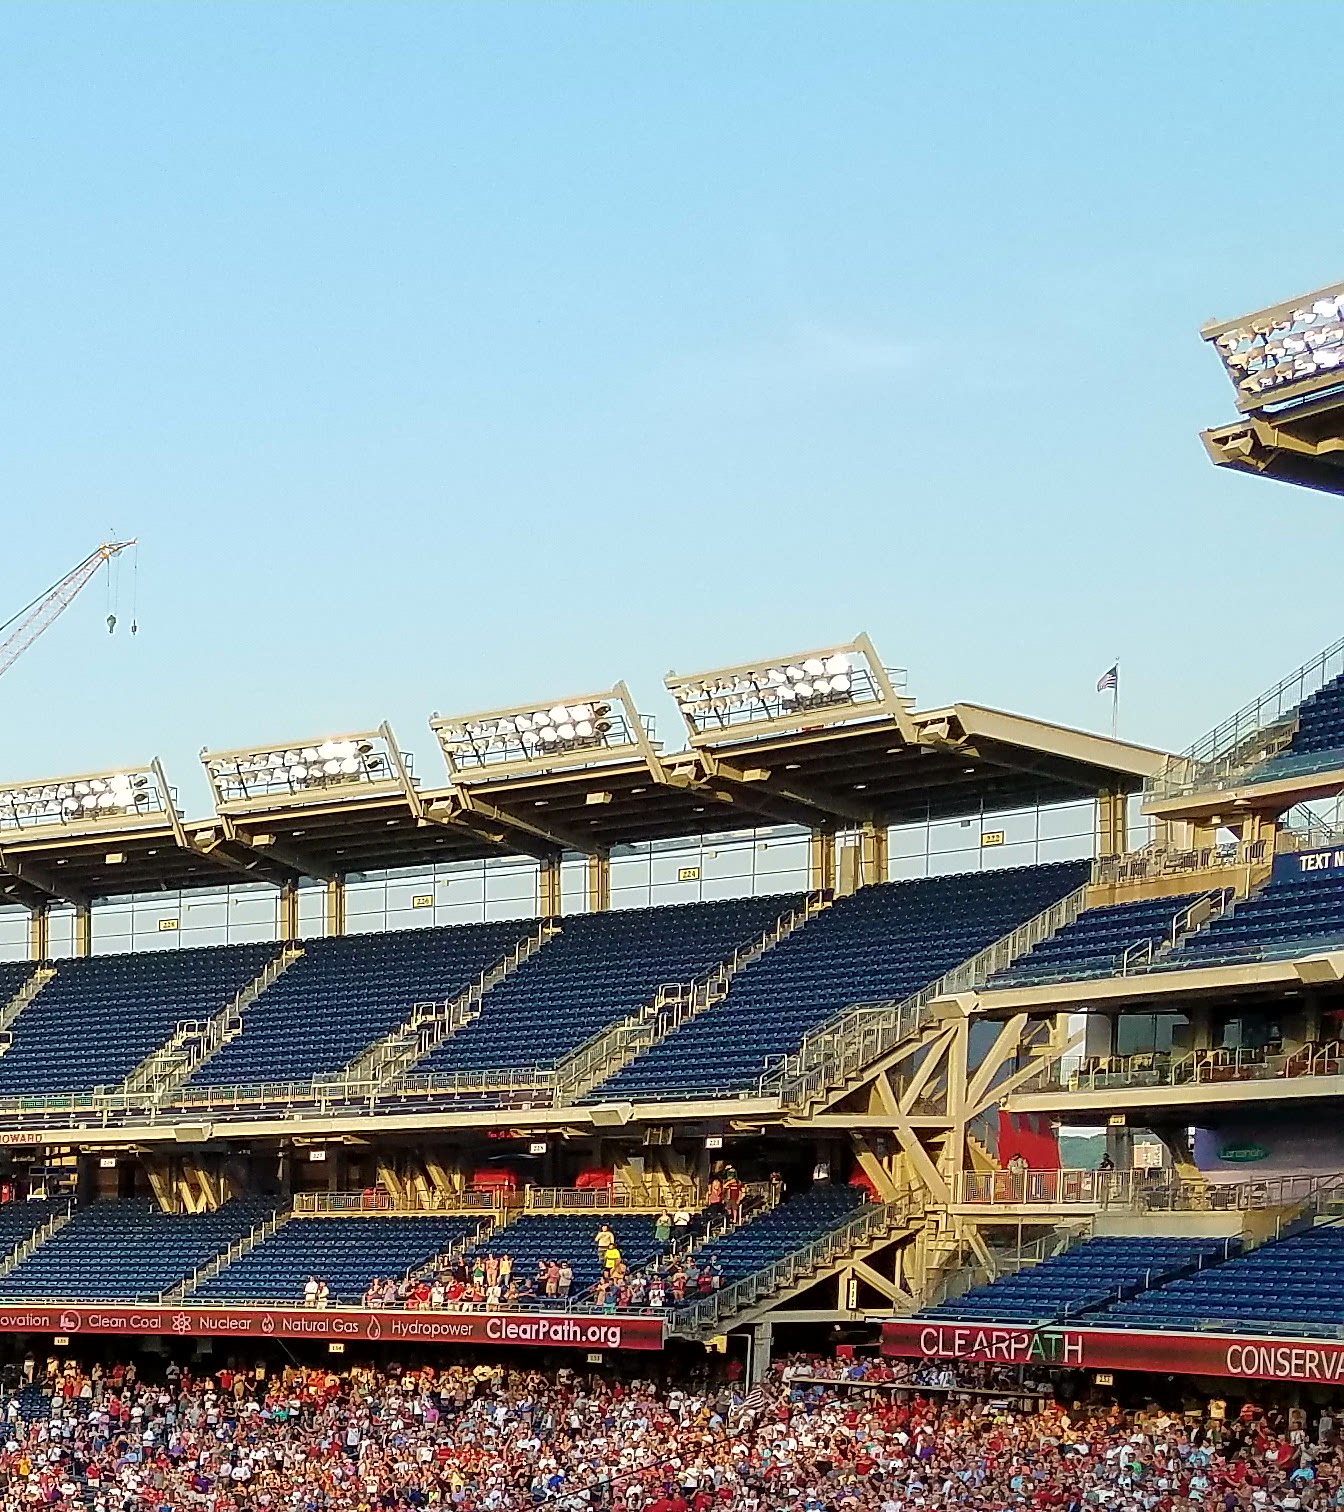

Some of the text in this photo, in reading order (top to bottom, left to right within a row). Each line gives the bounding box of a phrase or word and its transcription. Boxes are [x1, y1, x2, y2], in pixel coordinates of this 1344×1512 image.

[1300, 852, 1332, 871] TEXT
[88, 1314, 127, 1329] Clean
[129, 1315, 162, 1330] Coal
[199, 1316, 251, 1331] Nuclear
[282, 1317, 329, 1332] Natural
[331, 1319, 359, 1334] Gas
[391, 1320, 473, 1338] Hydropower
[486, 1317, 622, 1347] ClearPath.org
[920, 1327, 1083, 1364] CLEARPATH
